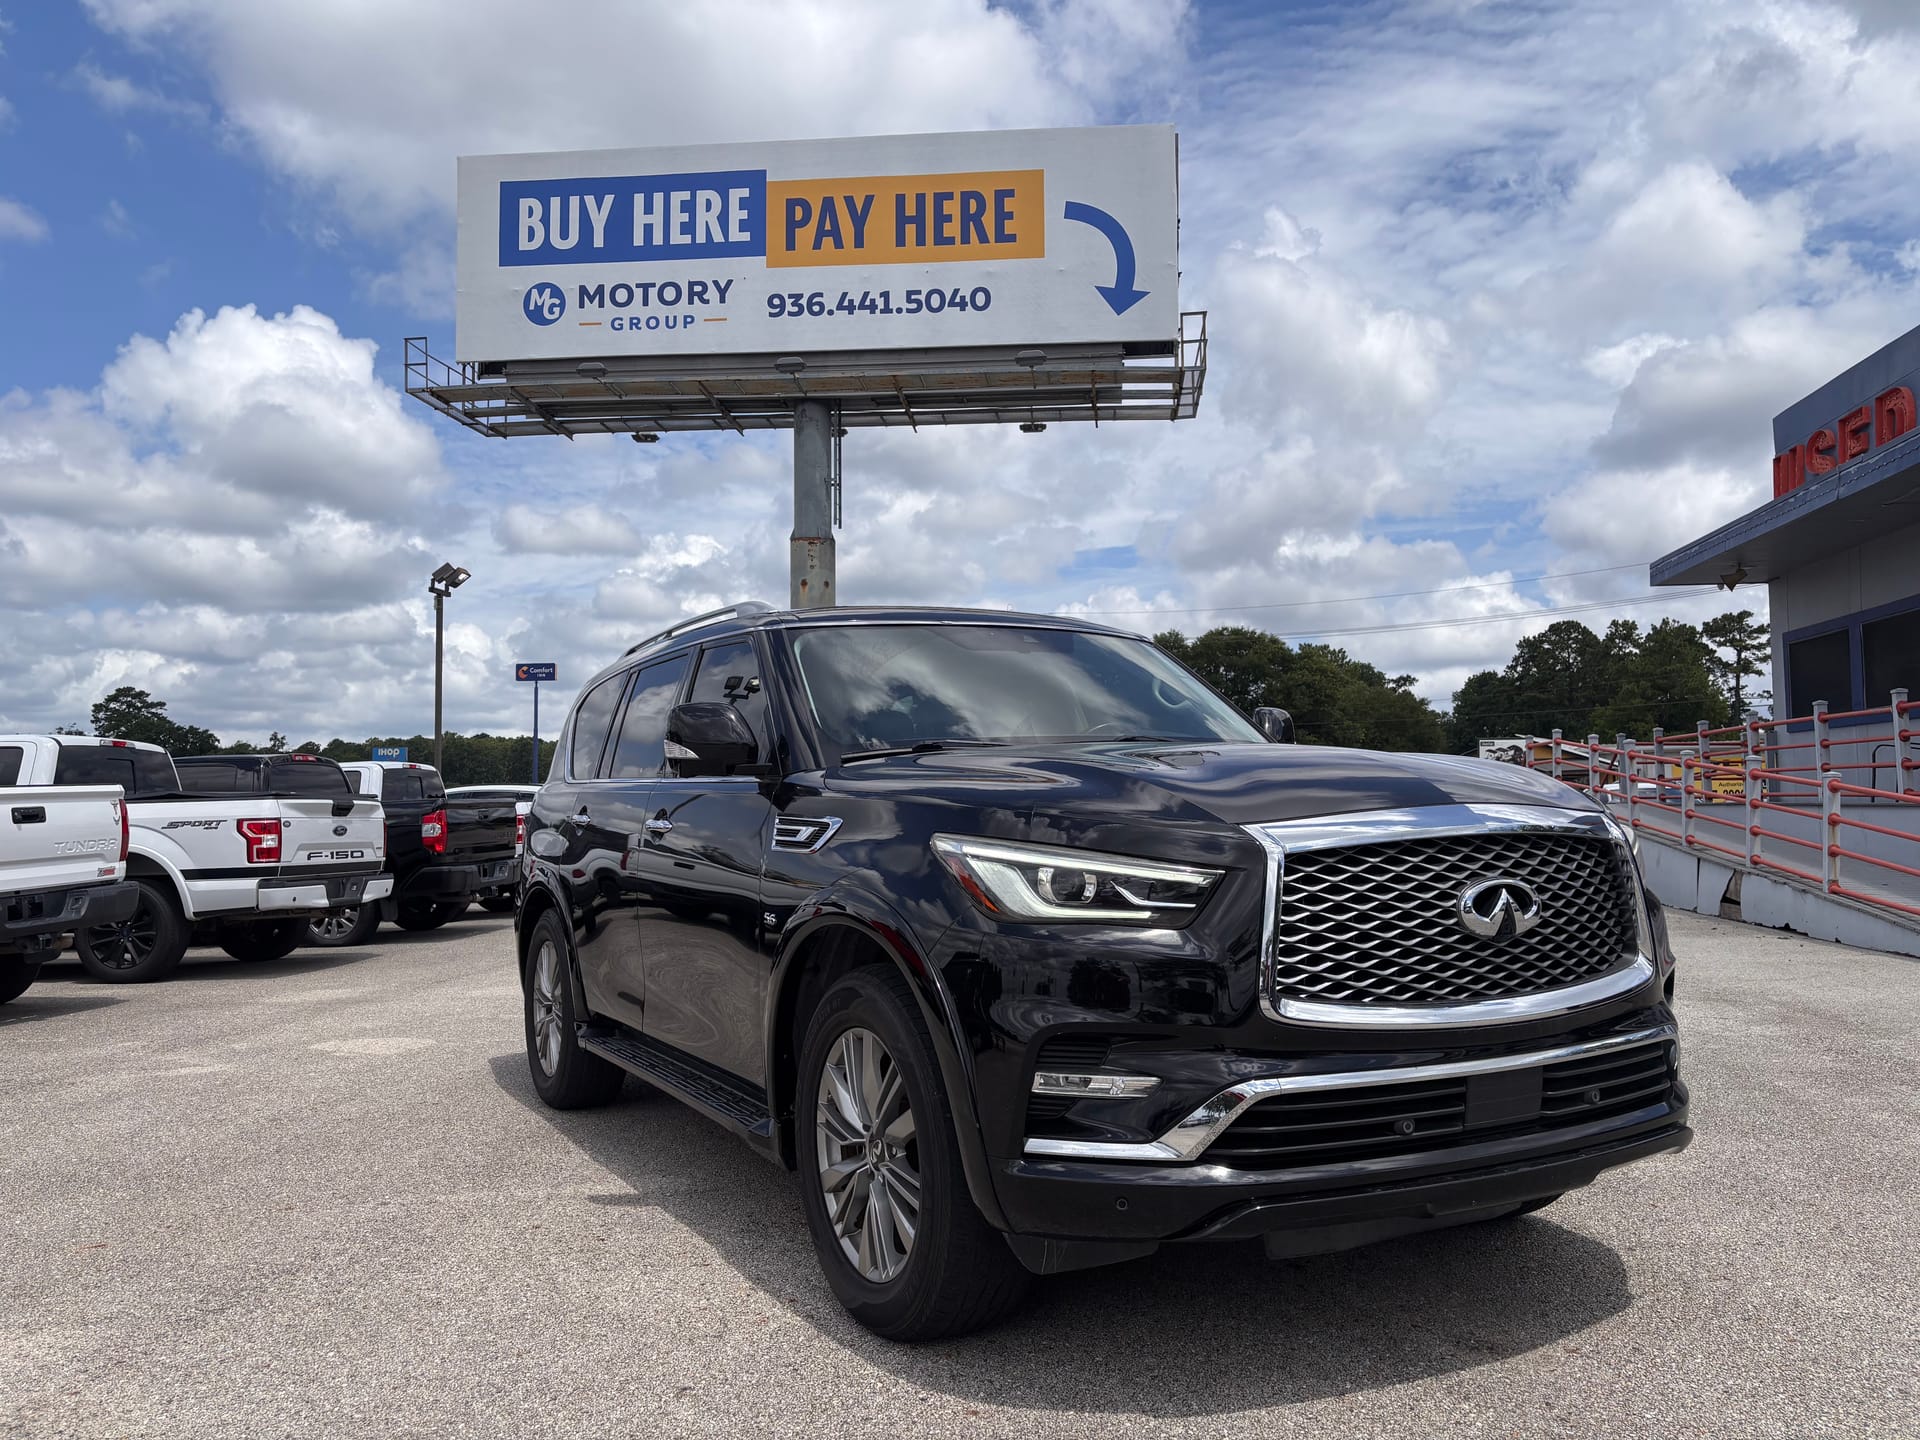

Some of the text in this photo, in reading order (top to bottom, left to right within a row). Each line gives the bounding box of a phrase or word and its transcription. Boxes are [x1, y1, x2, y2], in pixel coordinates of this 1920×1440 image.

[518, 188, 1017, 251] BUY HERE PAY HERE
[528, 288, 561, 320] MG
[578, 279, 734, 309] MOTORY
[767, 286, 991, 318] 936.441.5040
[610, 314, 695, 331] GROUP
[161, 820, 228, 830] SPORT
[54, 838, 118, 854] TUNDRA
[306, 849, 364, 861] F-150
